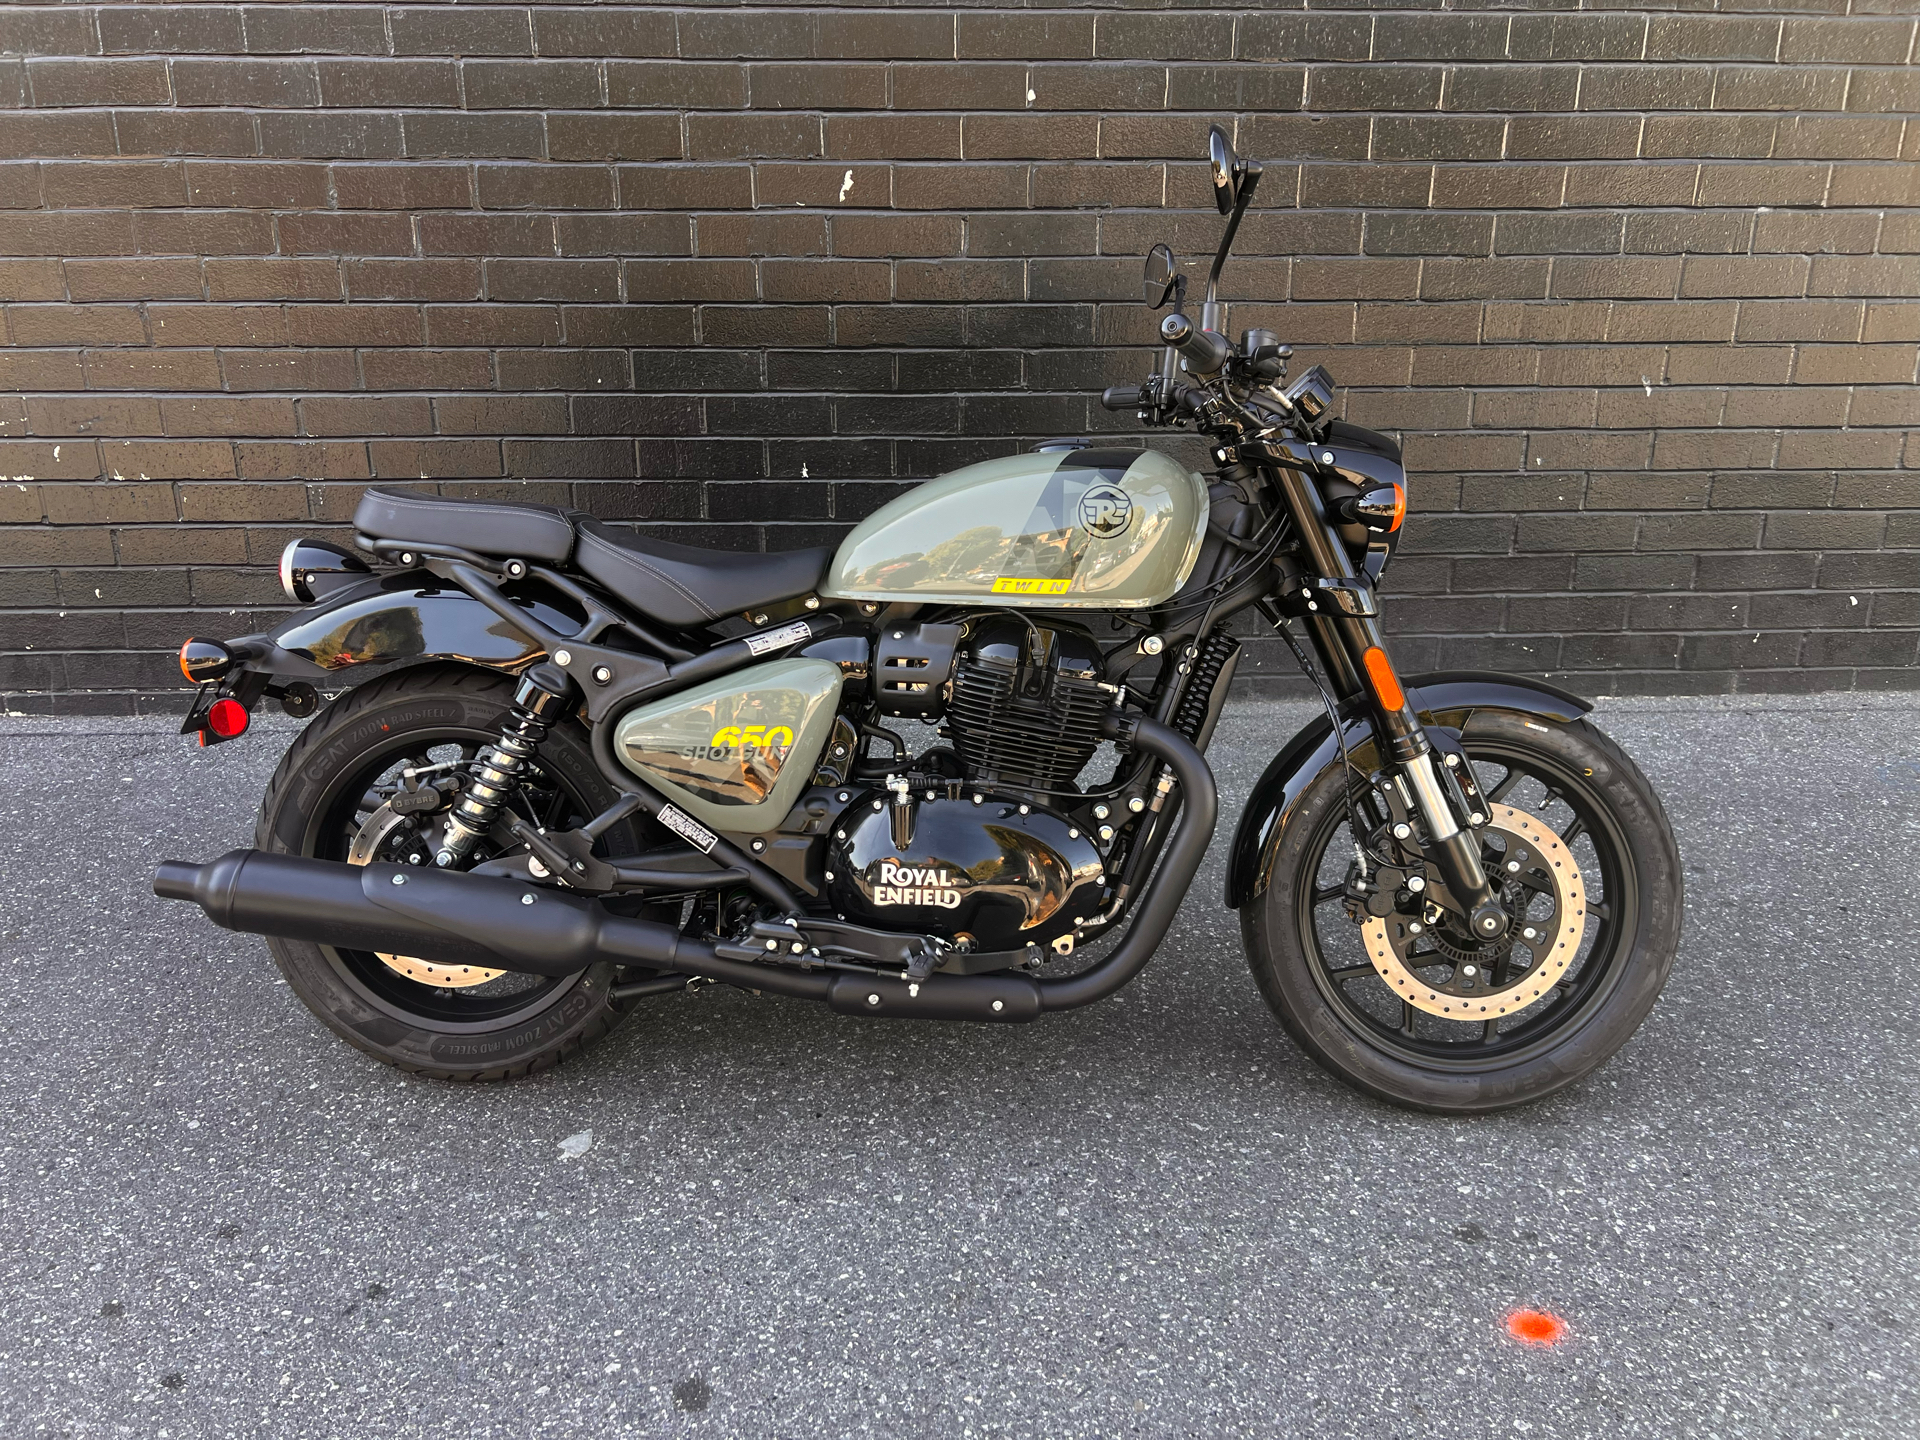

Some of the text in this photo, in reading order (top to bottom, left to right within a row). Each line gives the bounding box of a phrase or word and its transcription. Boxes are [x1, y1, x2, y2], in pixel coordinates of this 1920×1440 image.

[1000, 580, 1066, 592] TWIN
[308, 737, 350, 780] CEAT
[350, 716, 388, 745] ZOOM
[390, 711, 414, 726] RAD
[415, 707, 447, 719] STEEL
[710, 725, 794, 748] 650
[680, 746, 788, 761] SHOTGUN
[559, 751, 601, 794] 150/70
[880, 863, 952, 887] ROYAL
[873, 886, 961, 909] ENFIELD
[546, 994, 587, 1035] CEAT
[448, 1044, 478, 1055] STEEL
[479, 1040, 501, 1051] RAD
[505, 1026, 542, 1051] ZOOM
[1489, 1067, 1553, 1098] CEAT
